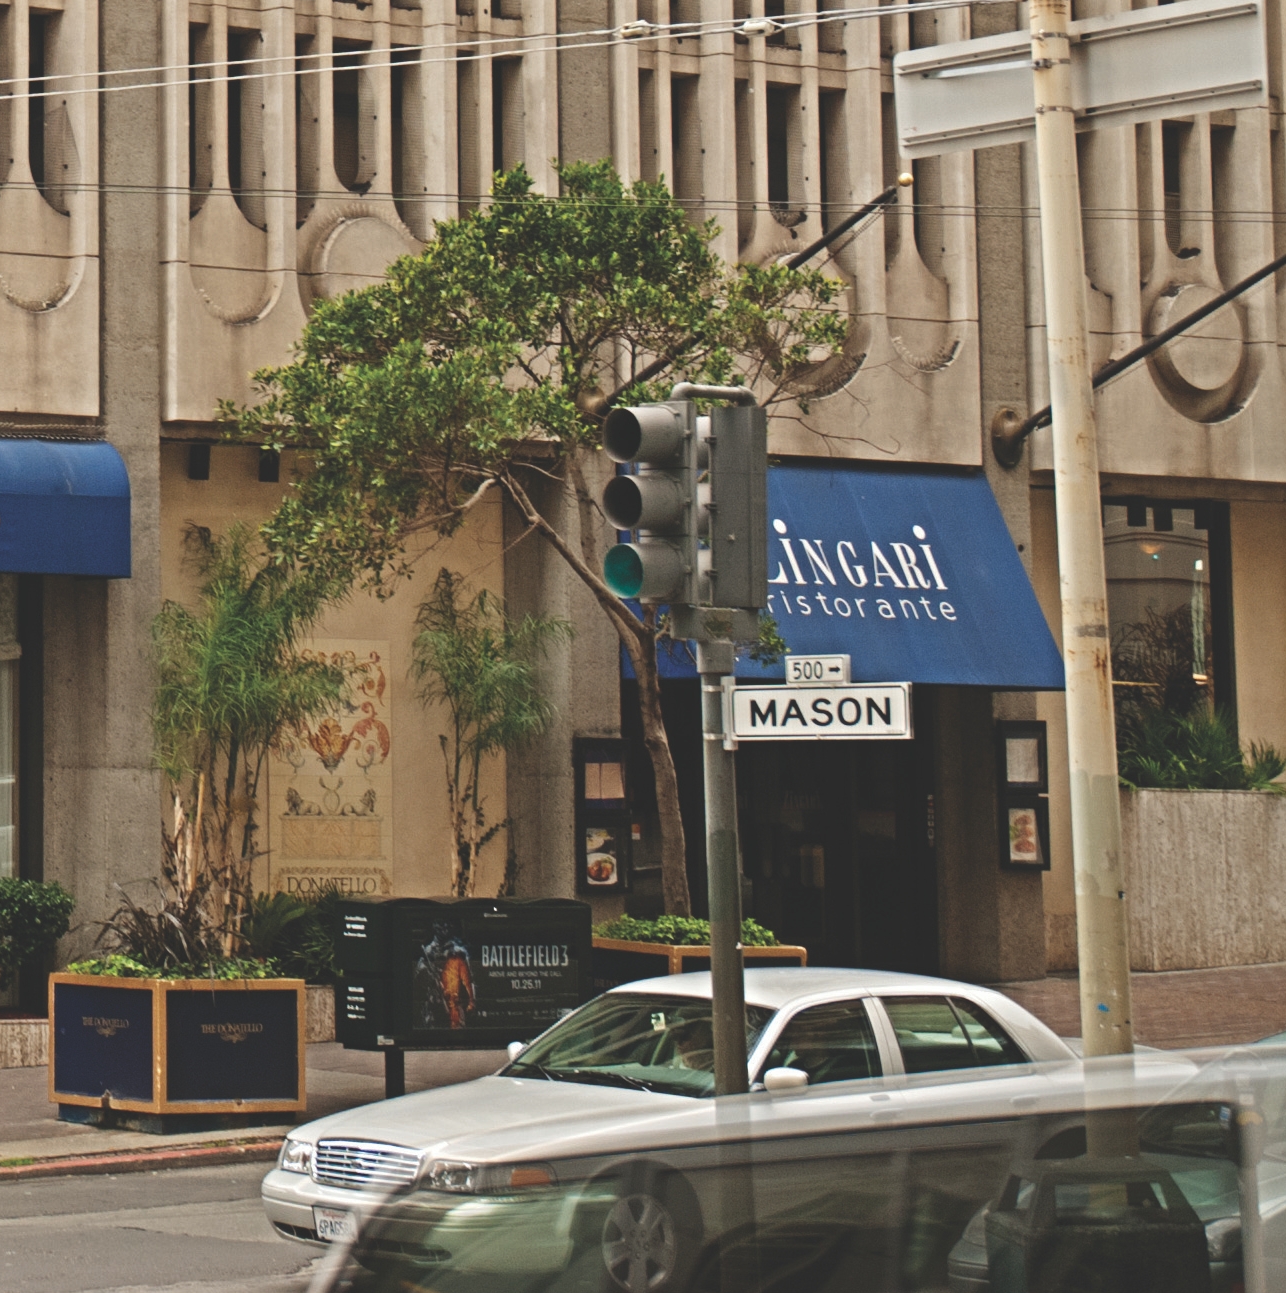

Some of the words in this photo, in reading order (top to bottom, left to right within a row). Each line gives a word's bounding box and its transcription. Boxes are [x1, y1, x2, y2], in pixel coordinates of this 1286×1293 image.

[767, 590, 958, 621] ristorante
[793, 661, 823, 680] 500
[749, 697, 892, 728] MASON
[287, 876, 378, 896] DONATELLO
[482, 945, 559, 967] BATTLEFIELD
[560, 945, 569, 967] 3
[510, 979, 542, 989] 10.25.11
[94, 1017, 130, 1028] DONATELLO
[201, 1024, 217, 1033] THE
[217, 1023, 263, 1033] DONATELLO
